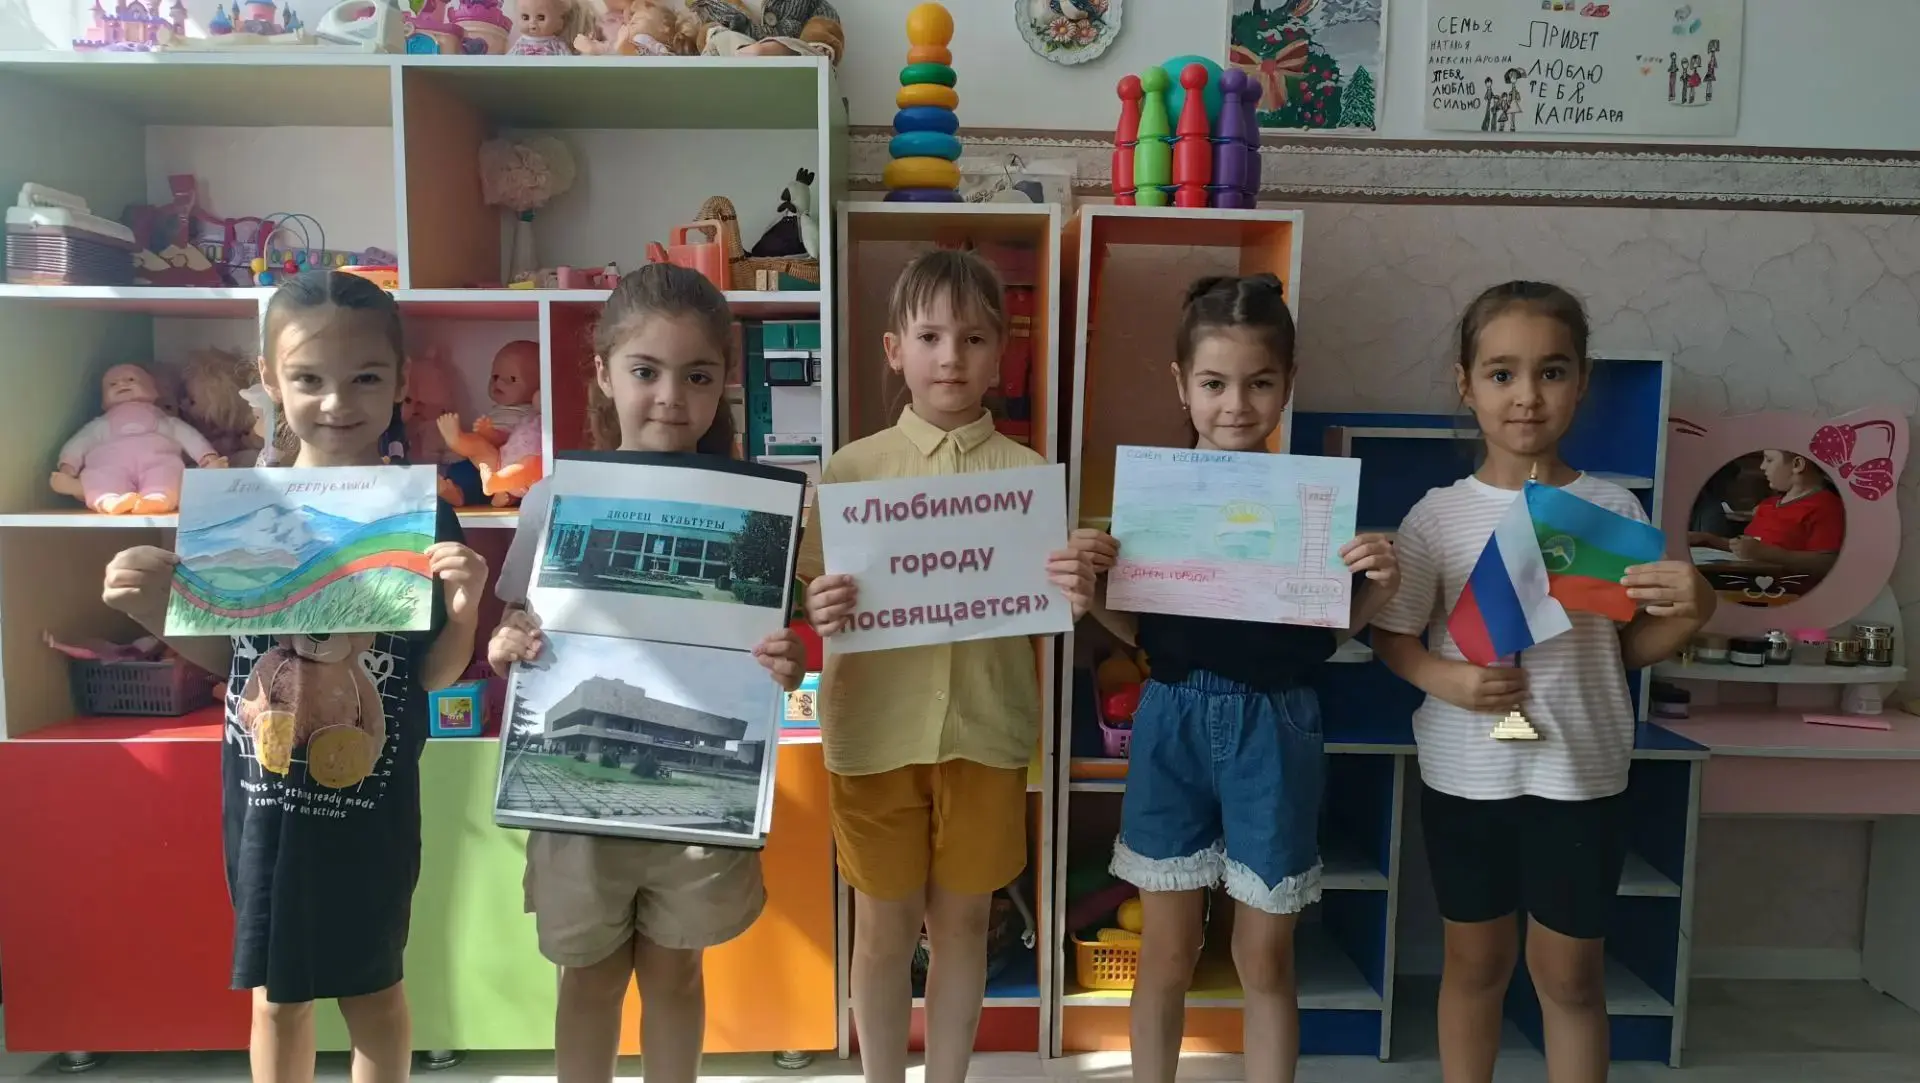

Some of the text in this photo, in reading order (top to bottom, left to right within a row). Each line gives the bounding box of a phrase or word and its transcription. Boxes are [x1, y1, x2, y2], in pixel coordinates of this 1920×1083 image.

[1437, 16, 1493, 34] СЕМЬЯ
[1518, 20, 1599, 51] ПРИВЕТ
[1528, 58, 1603, 84] ЛЮБЛЮ
[1432, 81, 1476, 97] ЛЮБЛЮ
[1529, 80, 1585, 104] ТЕБЯ
[1433, 97, 1481, 111] СИЛЬНО
[1534, 102, 1624, 125] КАПИБАРА
[842, 488, 1034, 524] «Любимому
[606, 509, 726, 530] ДВОРЕЦ КУЛЬТУРЫ
[889, 546, 995, 577] городу
[313, 792, 342, 808] ready
